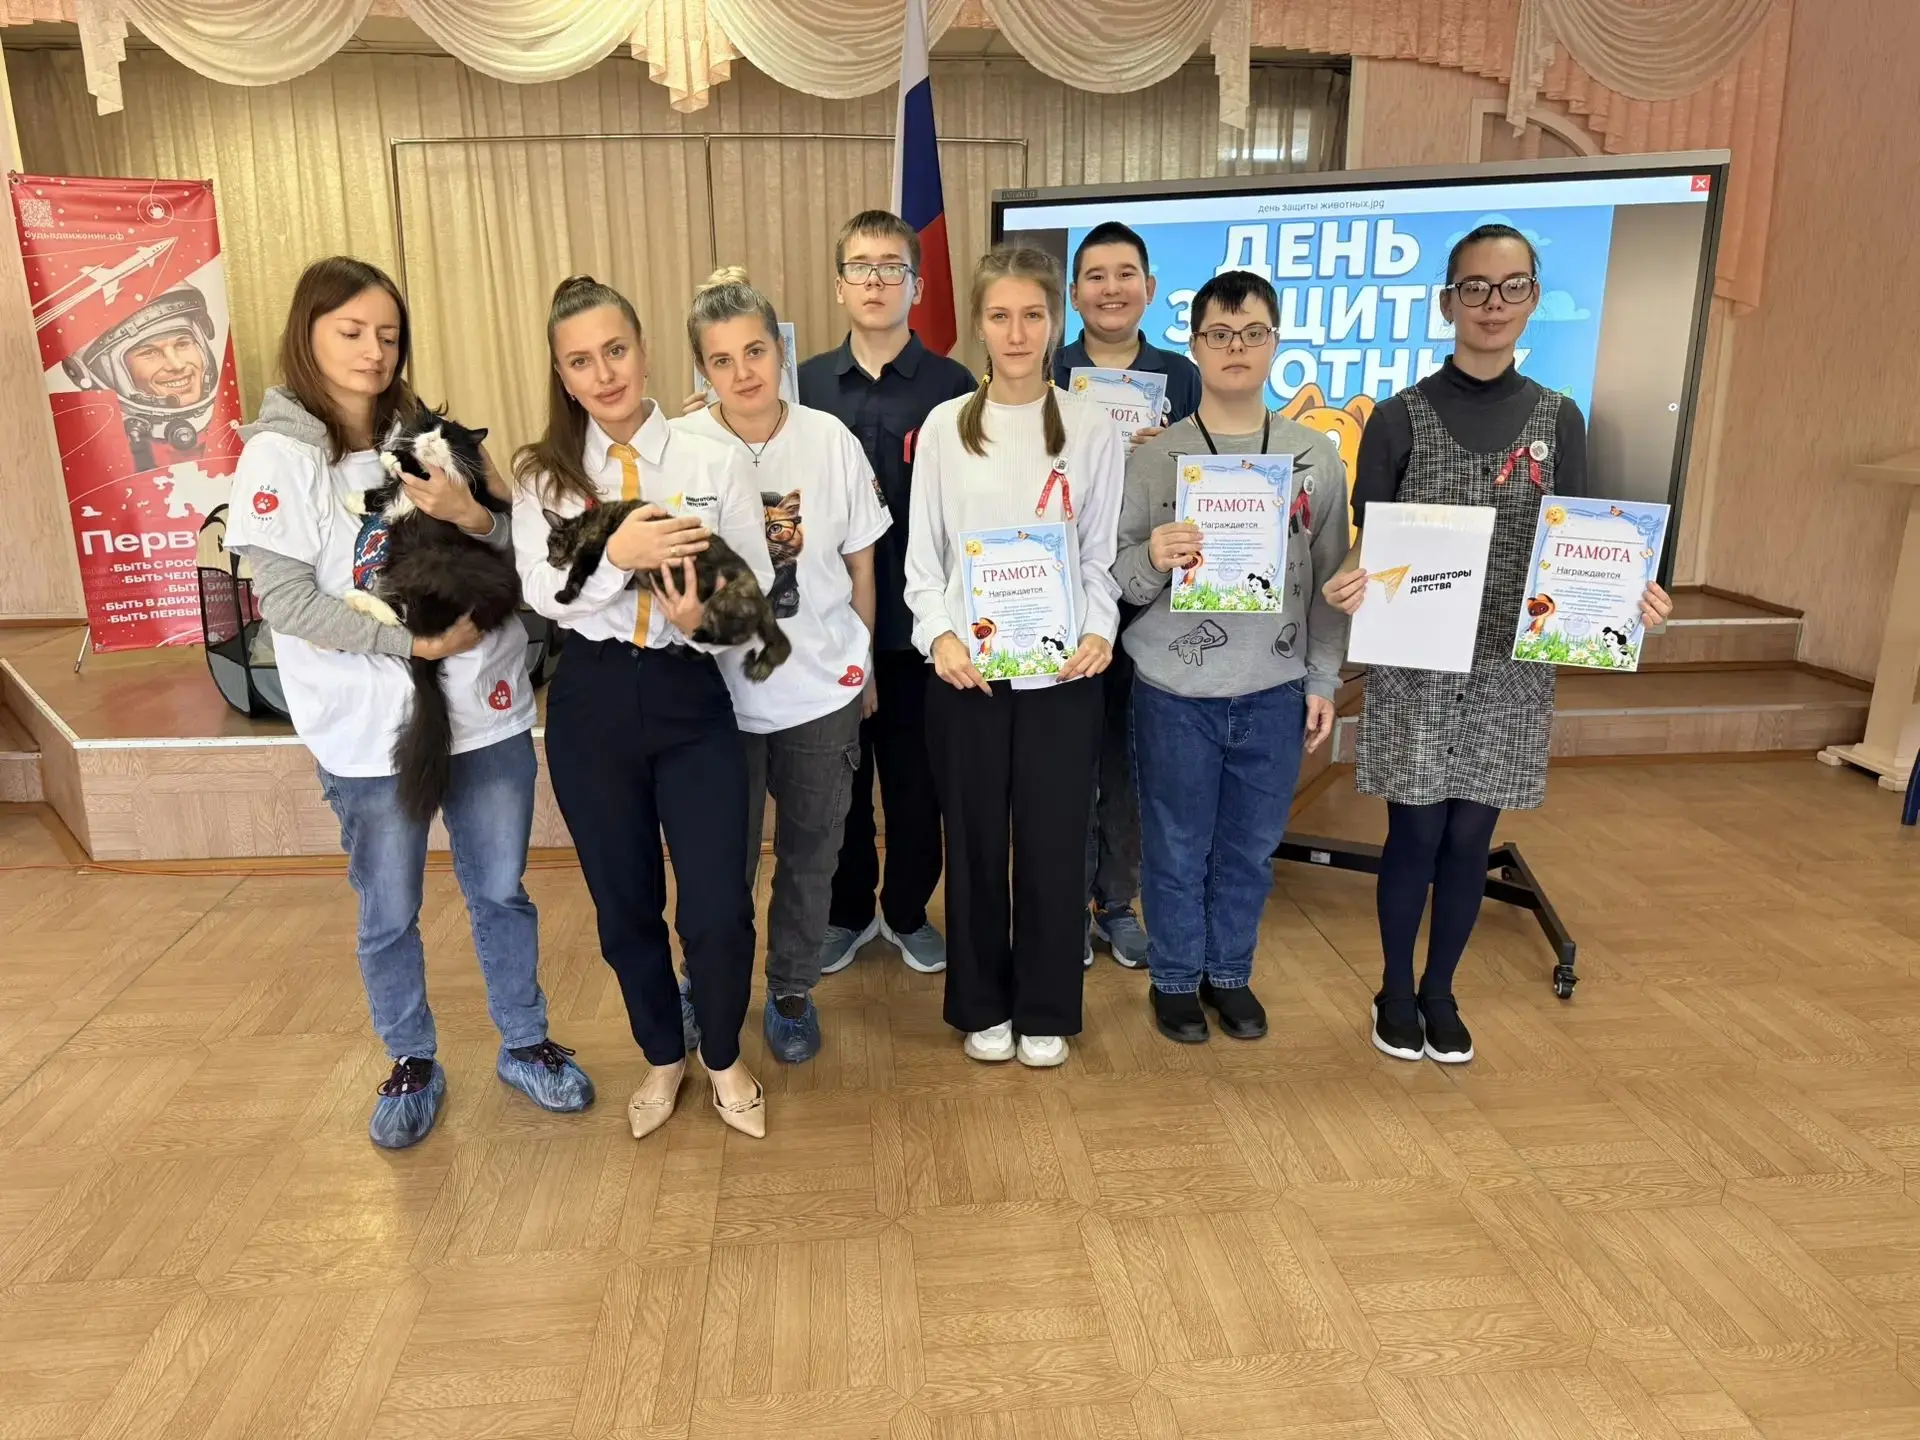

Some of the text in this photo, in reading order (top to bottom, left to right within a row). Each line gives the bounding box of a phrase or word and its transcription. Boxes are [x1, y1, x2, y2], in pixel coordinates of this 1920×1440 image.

[1258, 199, 1385, 213] день защиты животных.jpg
[1214, 217, 1421, 282] ДЕНЬ
[1165, 283, 1455, 346] ЗЩИТ
[1197, 498, 1265, 513] ГРАМОТА
[1200, 521, 1259, 530] Награждается
[81, 529, 200, 558] Перв
[1554, 542, 1632, 563] ГРАМОТА
[113, 559, 198, 573] БЫТЬ С РОСС
[1556, 566, 1621, 580] Награждается
[124, 574, 163, 584] БЫТЬ
[982, 565, 1048, 583] ГРАМОТА
[1410, 569, 1472, 584] НАВИГАТОРЫ
[168, 584, 200, 593] БЫТ
[988, 586, 1043, 599] Награждается
[1410, 581, 1452, 595] ДЕТСТВА
[106, 594, 232, 611] БЫТЬ В ДВИЖНИИ
[111, 612, 148, 623] БЫТЬ
